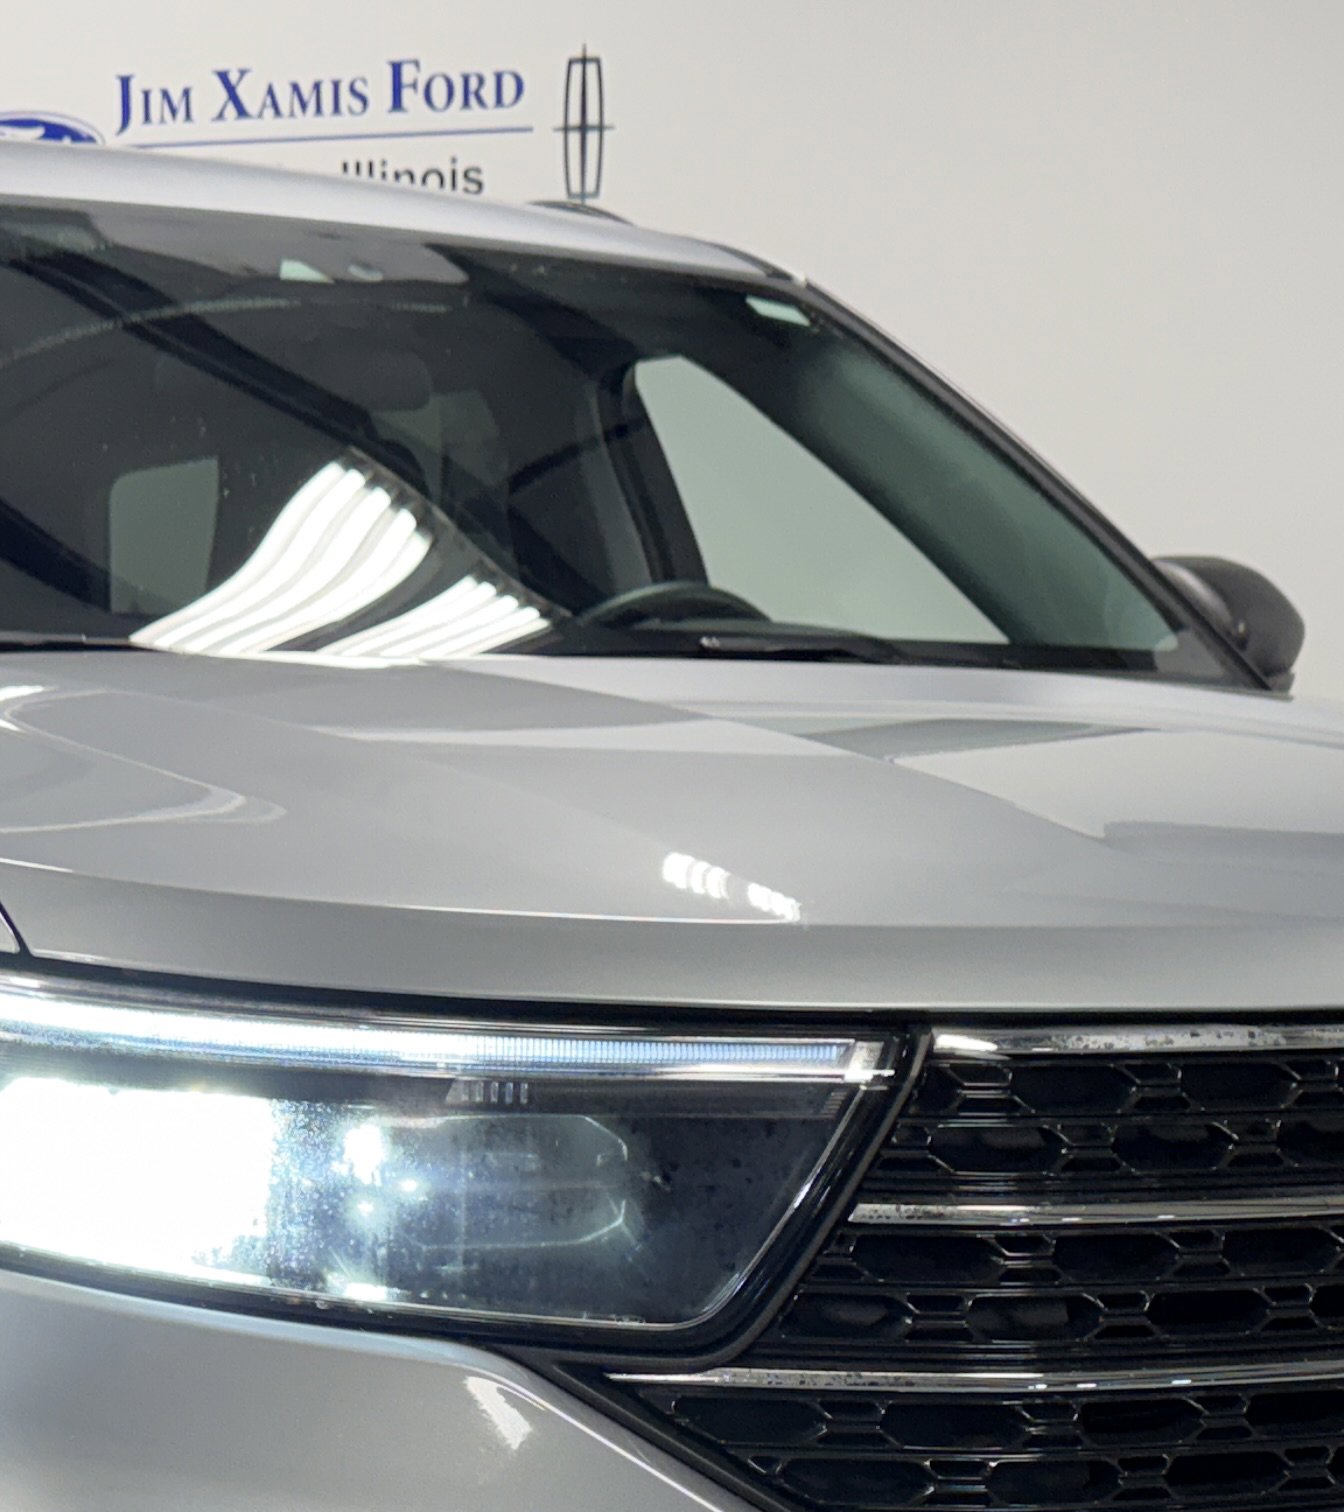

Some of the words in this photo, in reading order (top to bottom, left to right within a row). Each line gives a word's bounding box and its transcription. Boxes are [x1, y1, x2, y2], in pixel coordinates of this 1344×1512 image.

[116, 74, 193, 136] JIM
[212, 68, 369, 121] XAMIS
[387, 58, 524, 113] FORD
